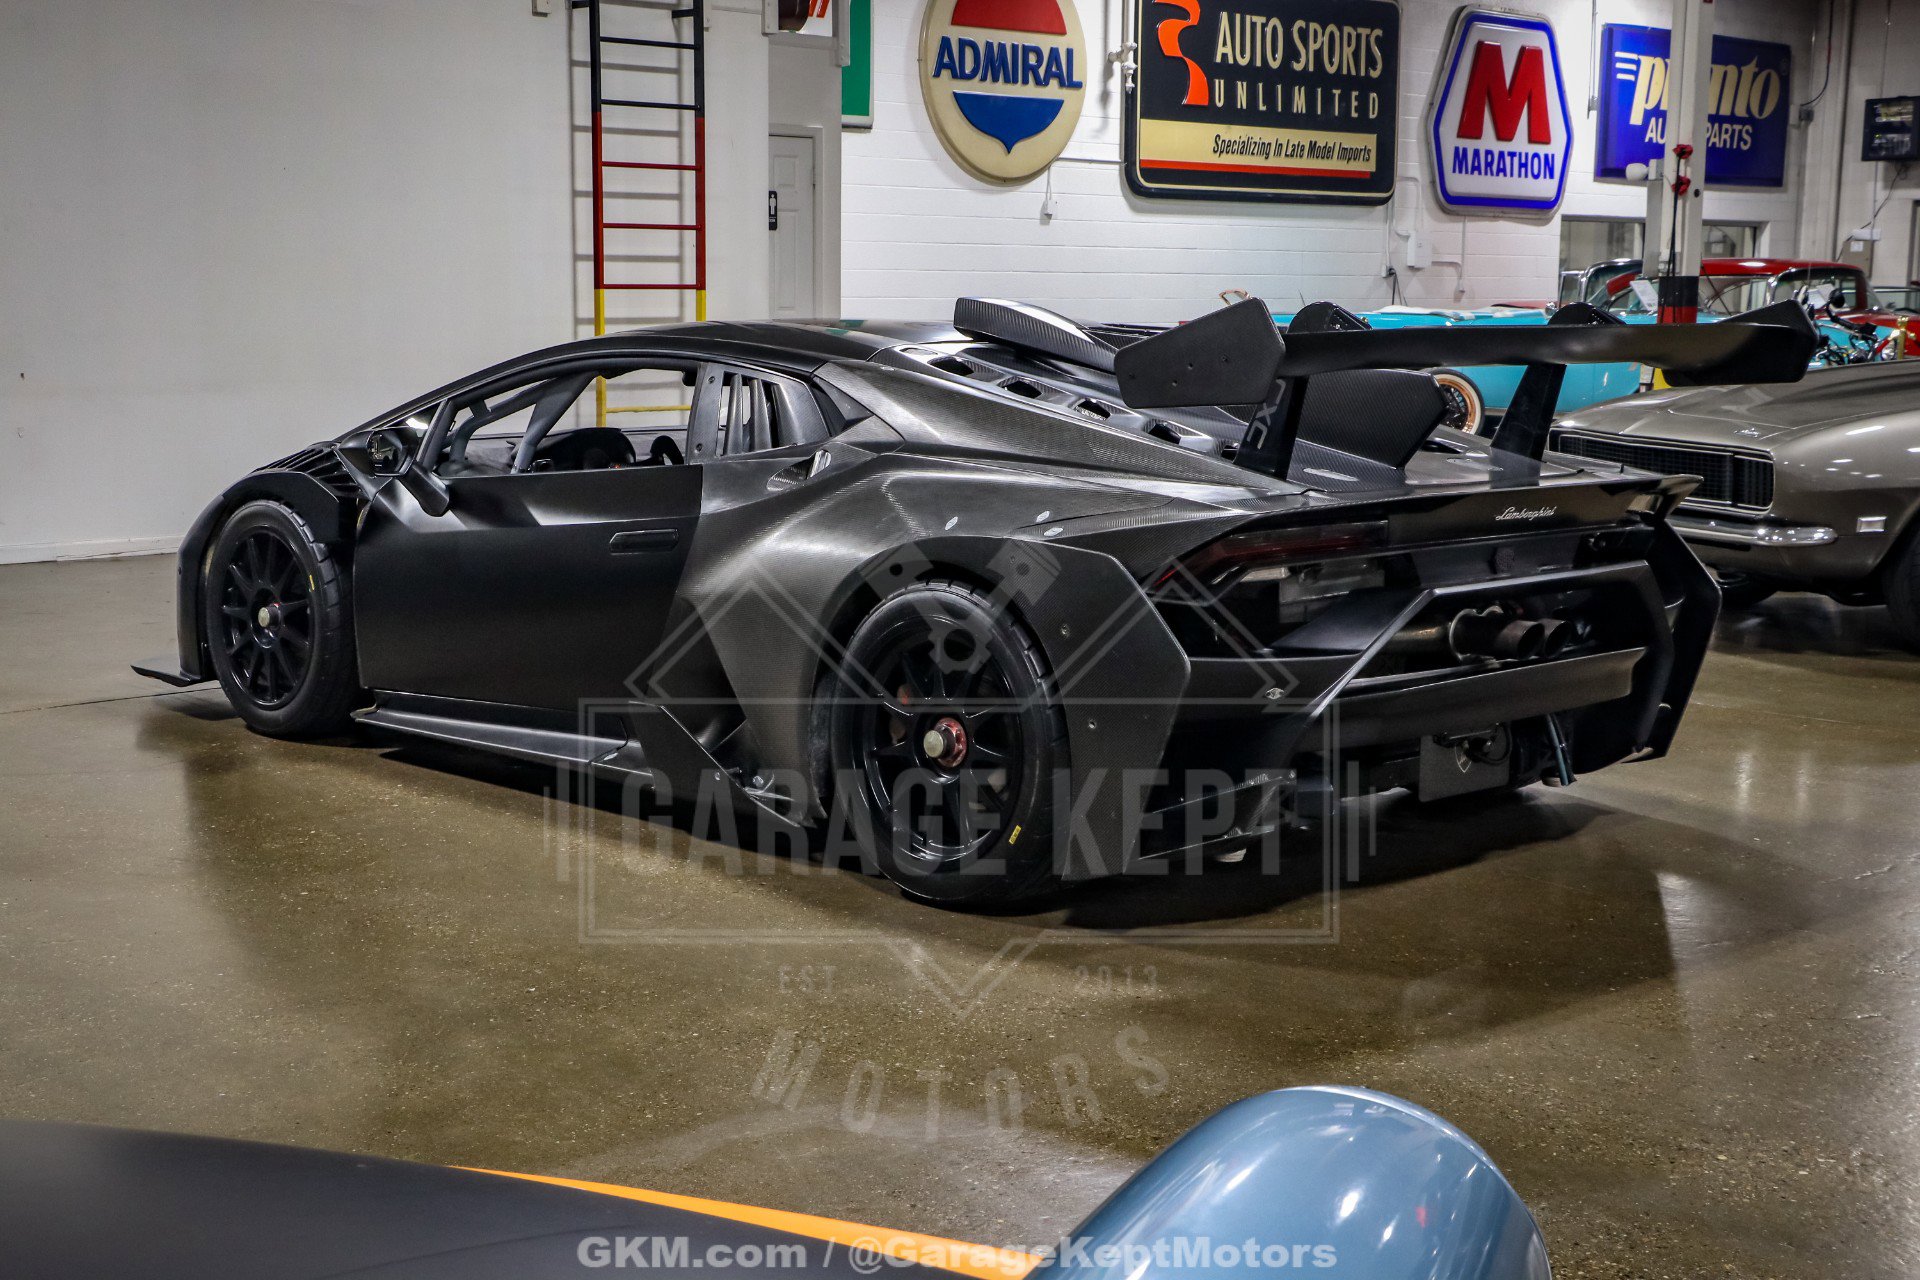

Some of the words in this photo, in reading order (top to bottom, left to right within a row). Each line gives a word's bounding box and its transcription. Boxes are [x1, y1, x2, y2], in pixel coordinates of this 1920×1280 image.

[932, 35, 1084, 89] ADMIRAL
[1214, 11, 1284, 70] AUTO
[1291, 19, 1383, 79] SPORTS
[1214, 78, 1379, 120] UNLIMITED
[1457, 39, 1552, 145] M
[1629, 55, 1781, 125] pnto
[1213, 133, 1272, 160] Specializing
[1273, 138, 1283, 157] In
[1285, 138, 1305, 158] Late
[1307, 140, 1336, 160] Model
[1337, 142, 1372, 164] Imports
[1452, 146, 1556, 181] MARATHON
[1495, 506, 1557, 521] Lamborghini
